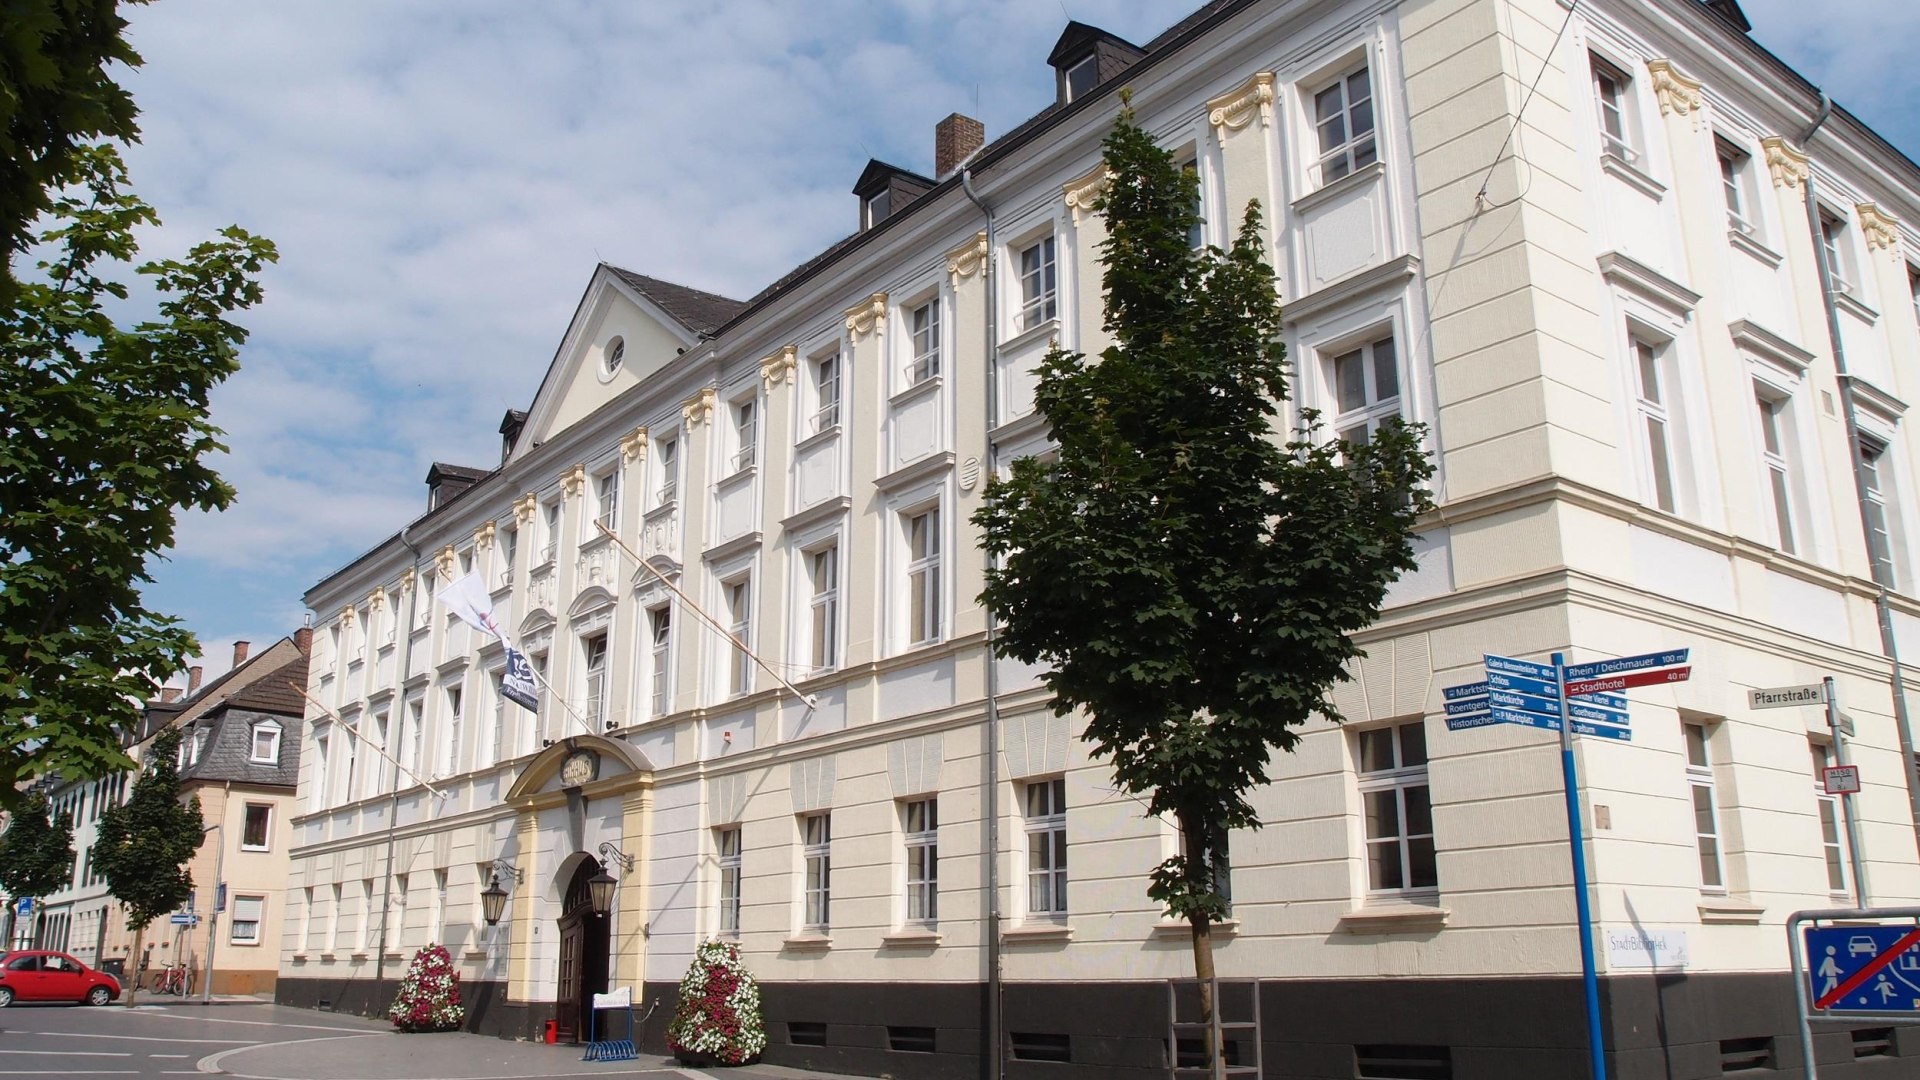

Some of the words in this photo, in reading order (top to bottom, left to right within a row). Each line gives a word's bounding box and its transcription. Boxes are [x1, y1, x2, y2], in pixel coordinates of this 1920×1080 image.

[1569, 668, 1594, 677] Rhein
[1595, 666, 1600, 674] /
[1601, 658, 1655, 674] Deichmauer
[1662, 655, 1675, 663] 100
[1490, 674, 1510, 686] Schloss
[1580, 678, 1625, 693] Stadthotel
[1667, 673, 1677, 681] 40
[1754, 688, 1818, 705] Pfarrstraße
[1505, 711, 1535, 725] Marktplatz
